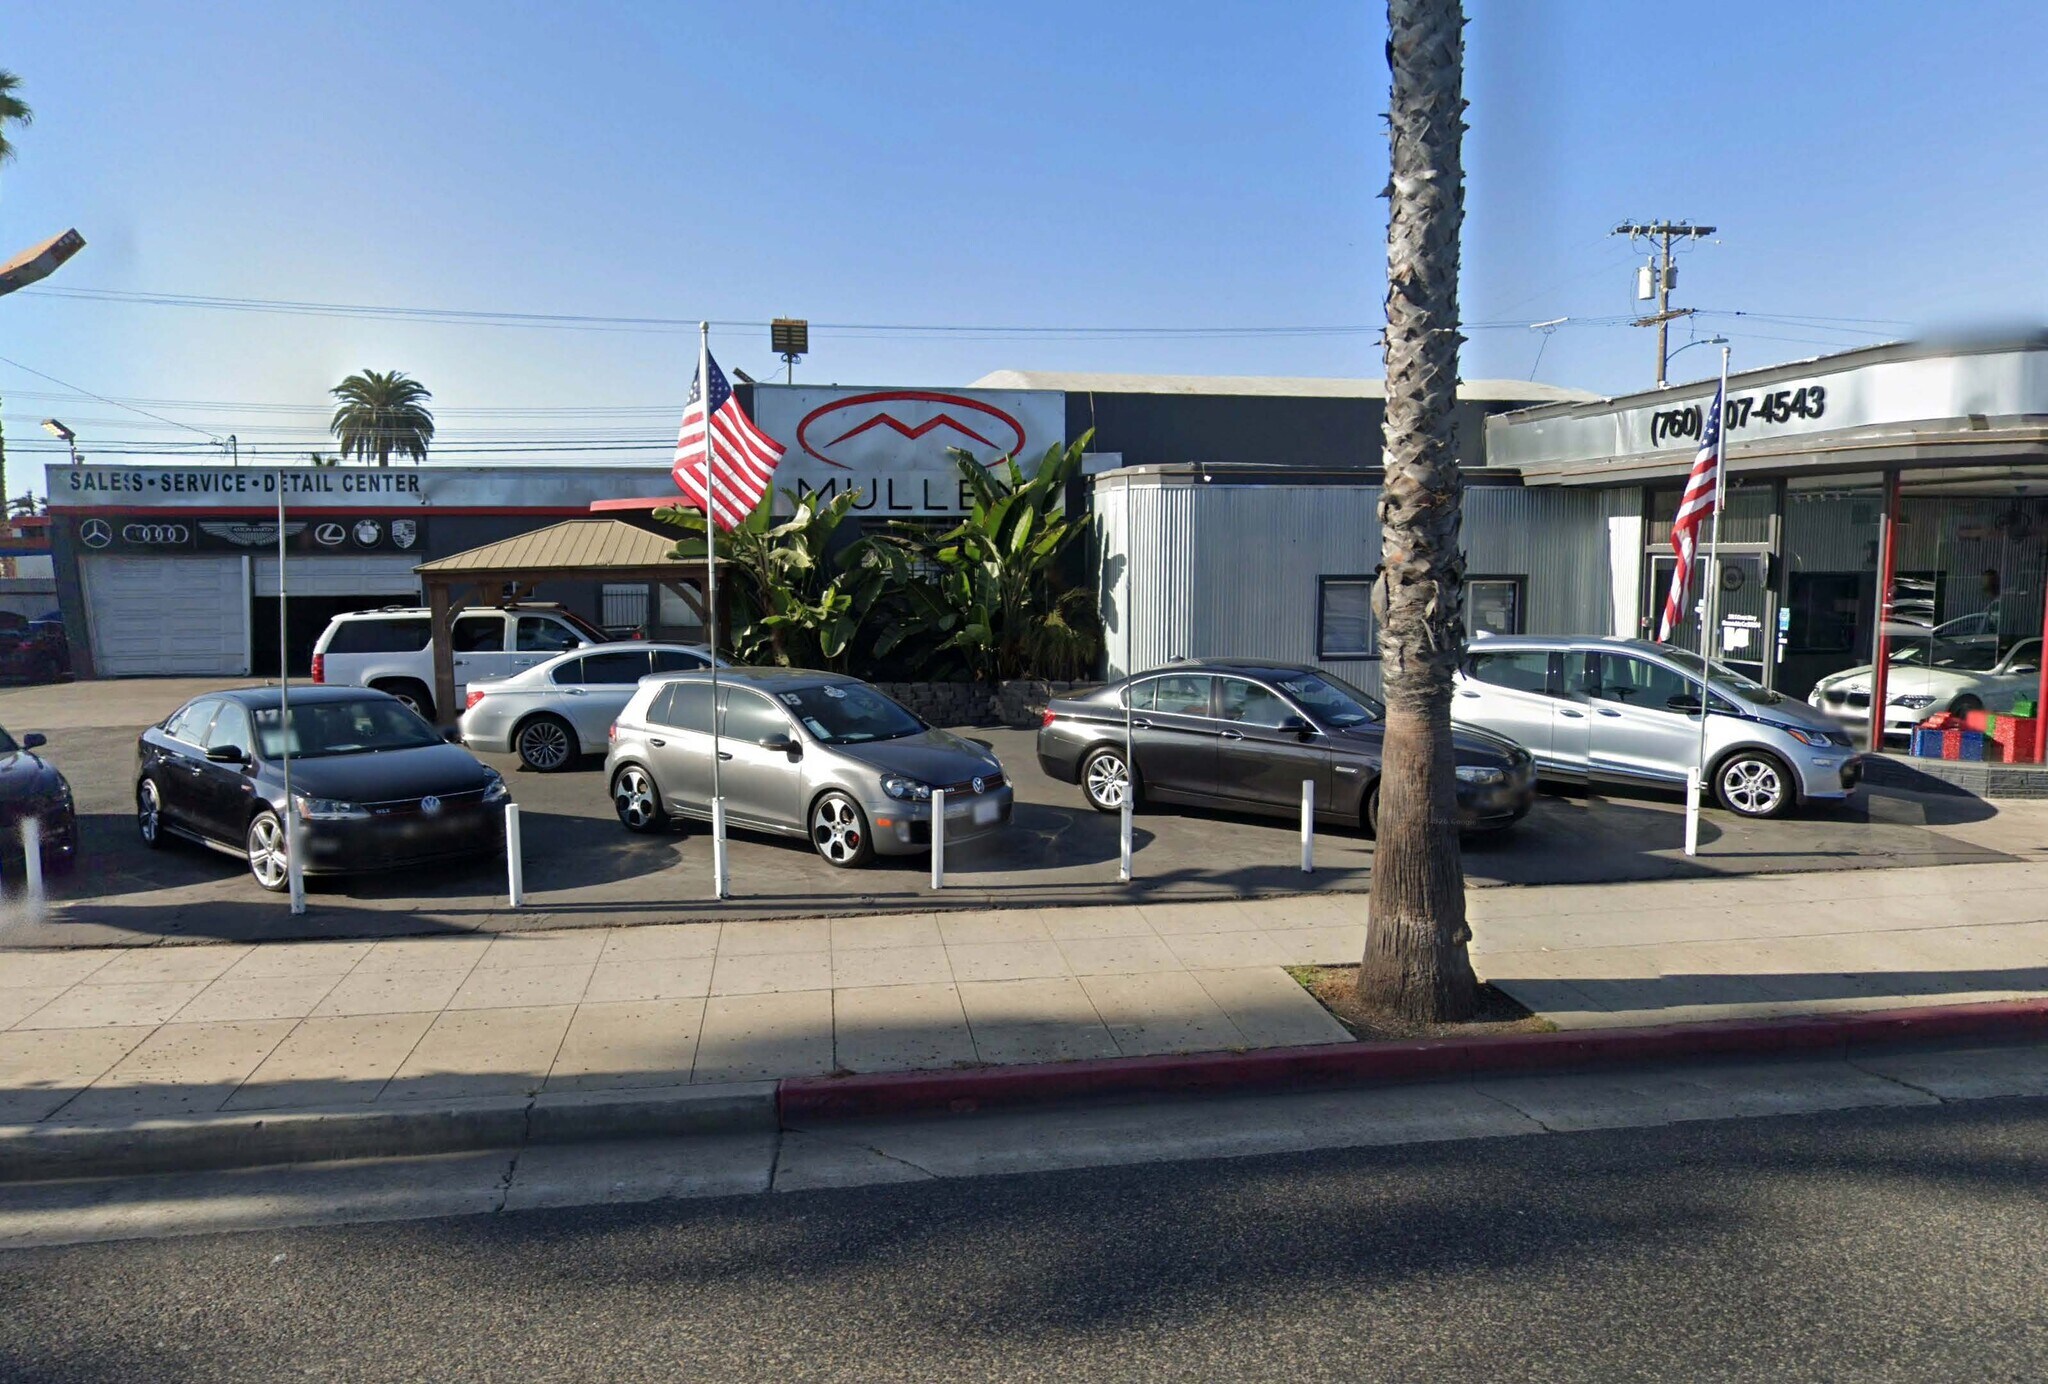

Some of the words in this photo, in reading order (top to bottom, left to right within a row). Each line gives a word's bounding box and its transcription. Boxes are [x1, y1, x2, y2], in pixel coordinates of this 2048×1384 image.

[1651, 404, 1703, 447] (760)
[1724, 385, 1825, 430] 07-4543
[160, 473, 246, 492] SERVICE
[264, 474, 333, 493] DETAIL
[342, 474, 420, 493] CENTER
[778, 693, 803, 706] 13
